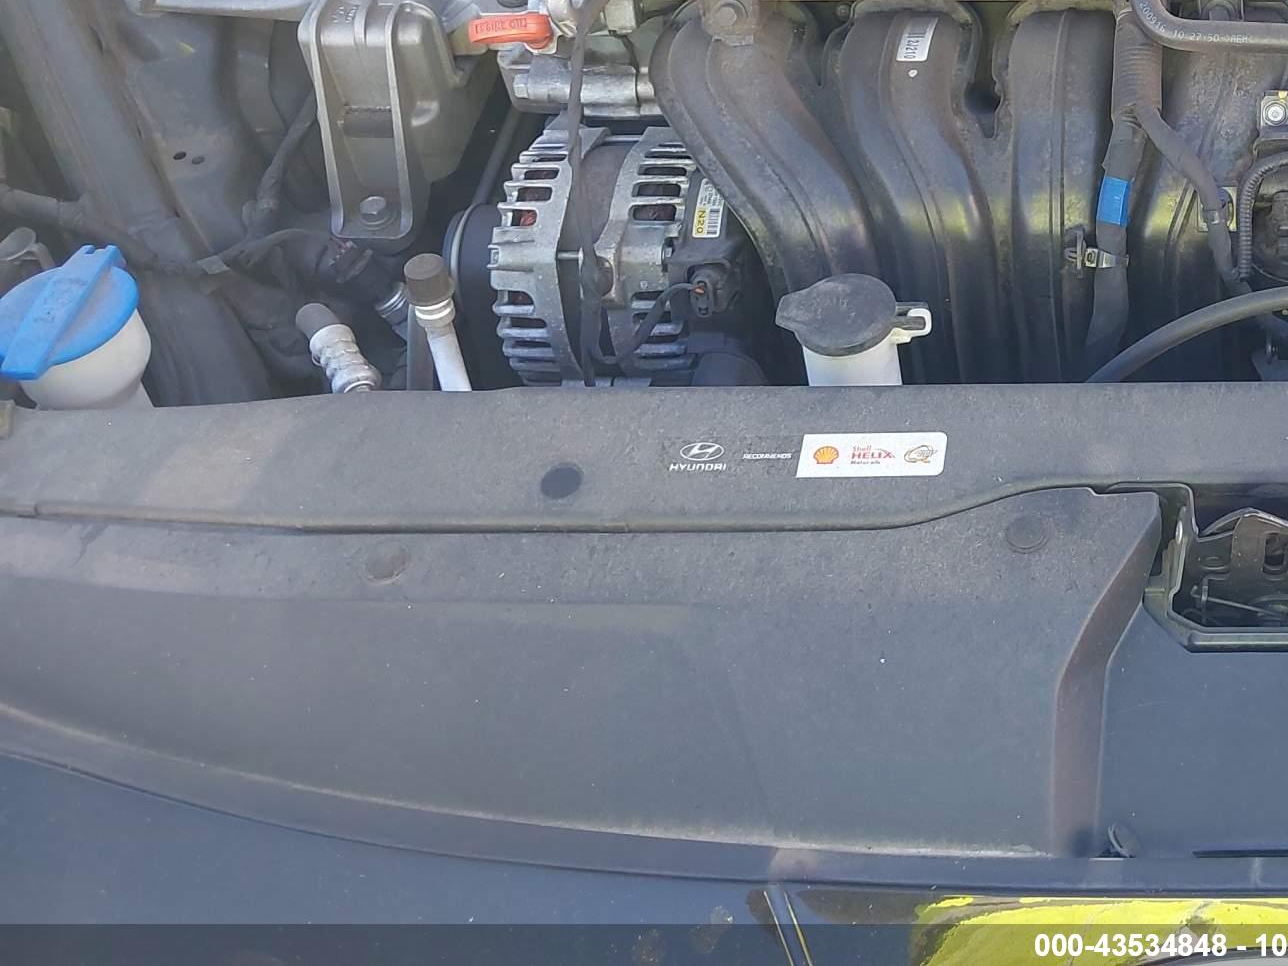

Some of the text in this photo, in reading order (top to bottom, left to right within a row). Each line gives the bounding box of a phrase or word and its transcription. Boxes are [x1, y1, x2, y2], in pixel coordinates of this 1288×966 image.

[696, 210, 706, 234] N20
[669, 463, 727, 472] HYUNDAI
[851, 451, 893, 459] HELIX
